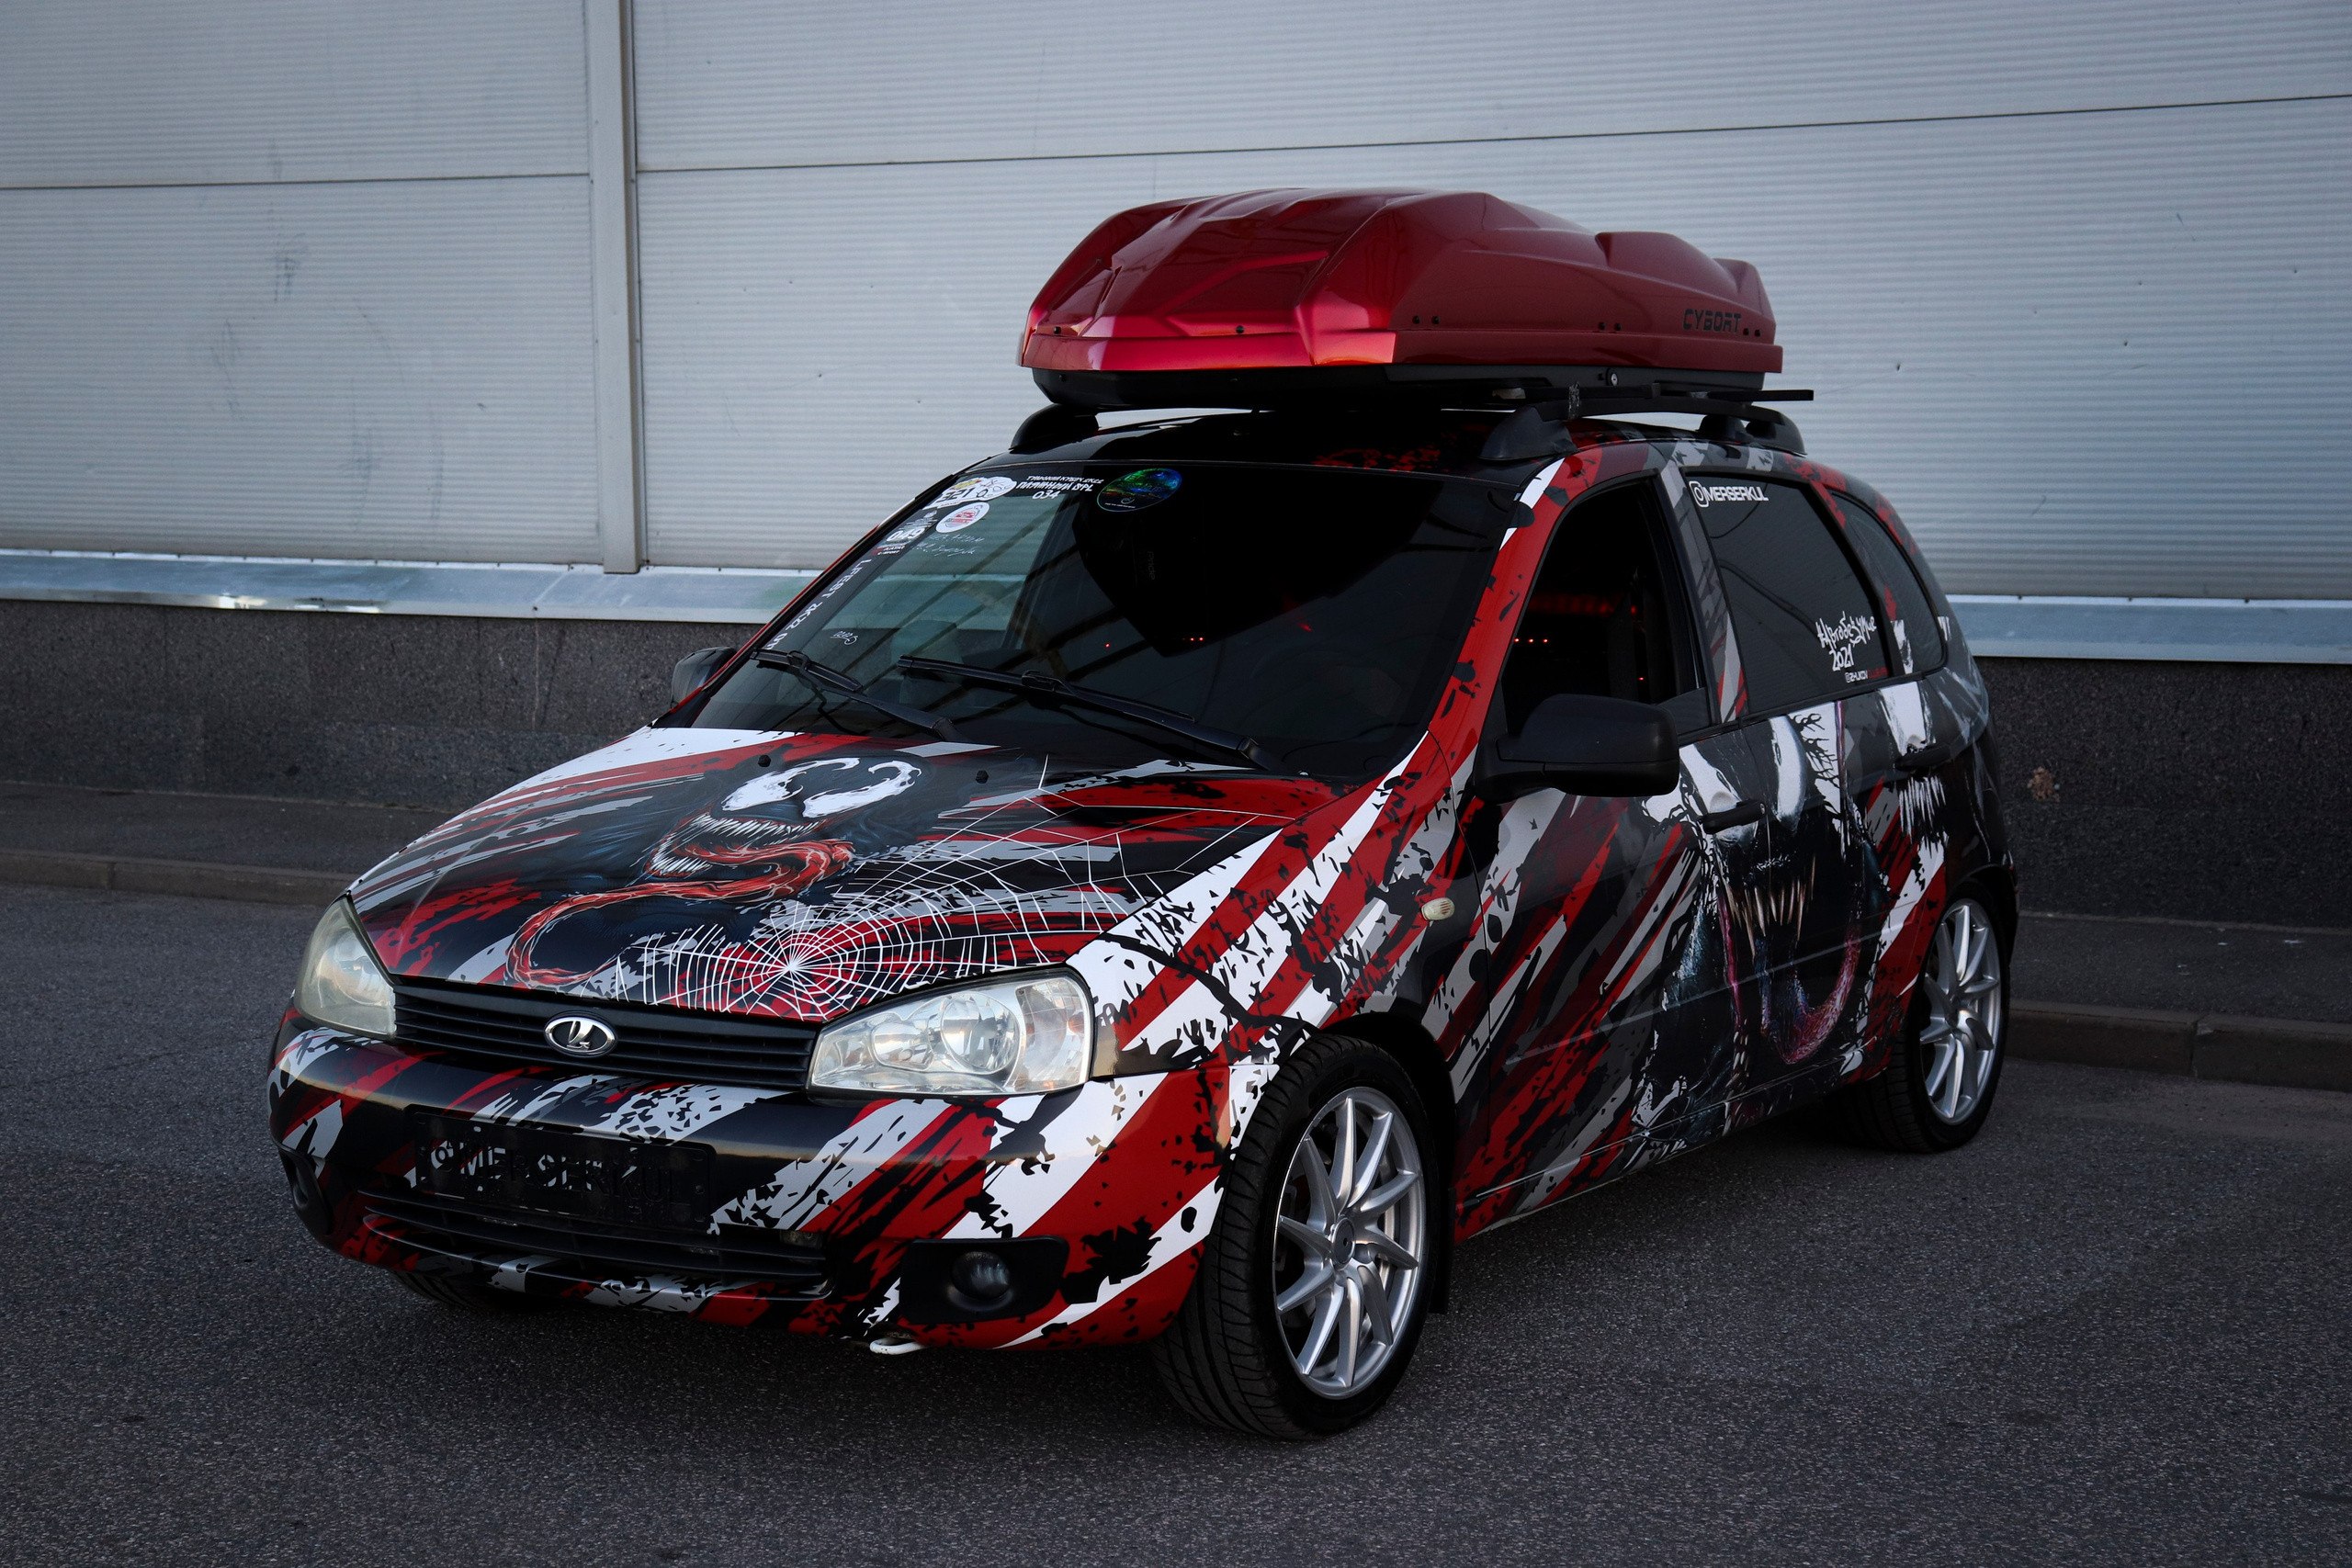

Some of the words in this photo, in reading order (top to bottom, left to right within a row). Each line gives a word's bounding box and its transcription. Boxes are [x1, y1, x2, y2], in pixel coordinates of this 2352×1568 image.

[1683, 309, 1741, 333] CYBORT
[935, 487, 976, 503] 321
[1032, 489, 1061, 500] 034
[886, 527, 925, 542] 049
[1828, 643, 1854, 671] 2021
